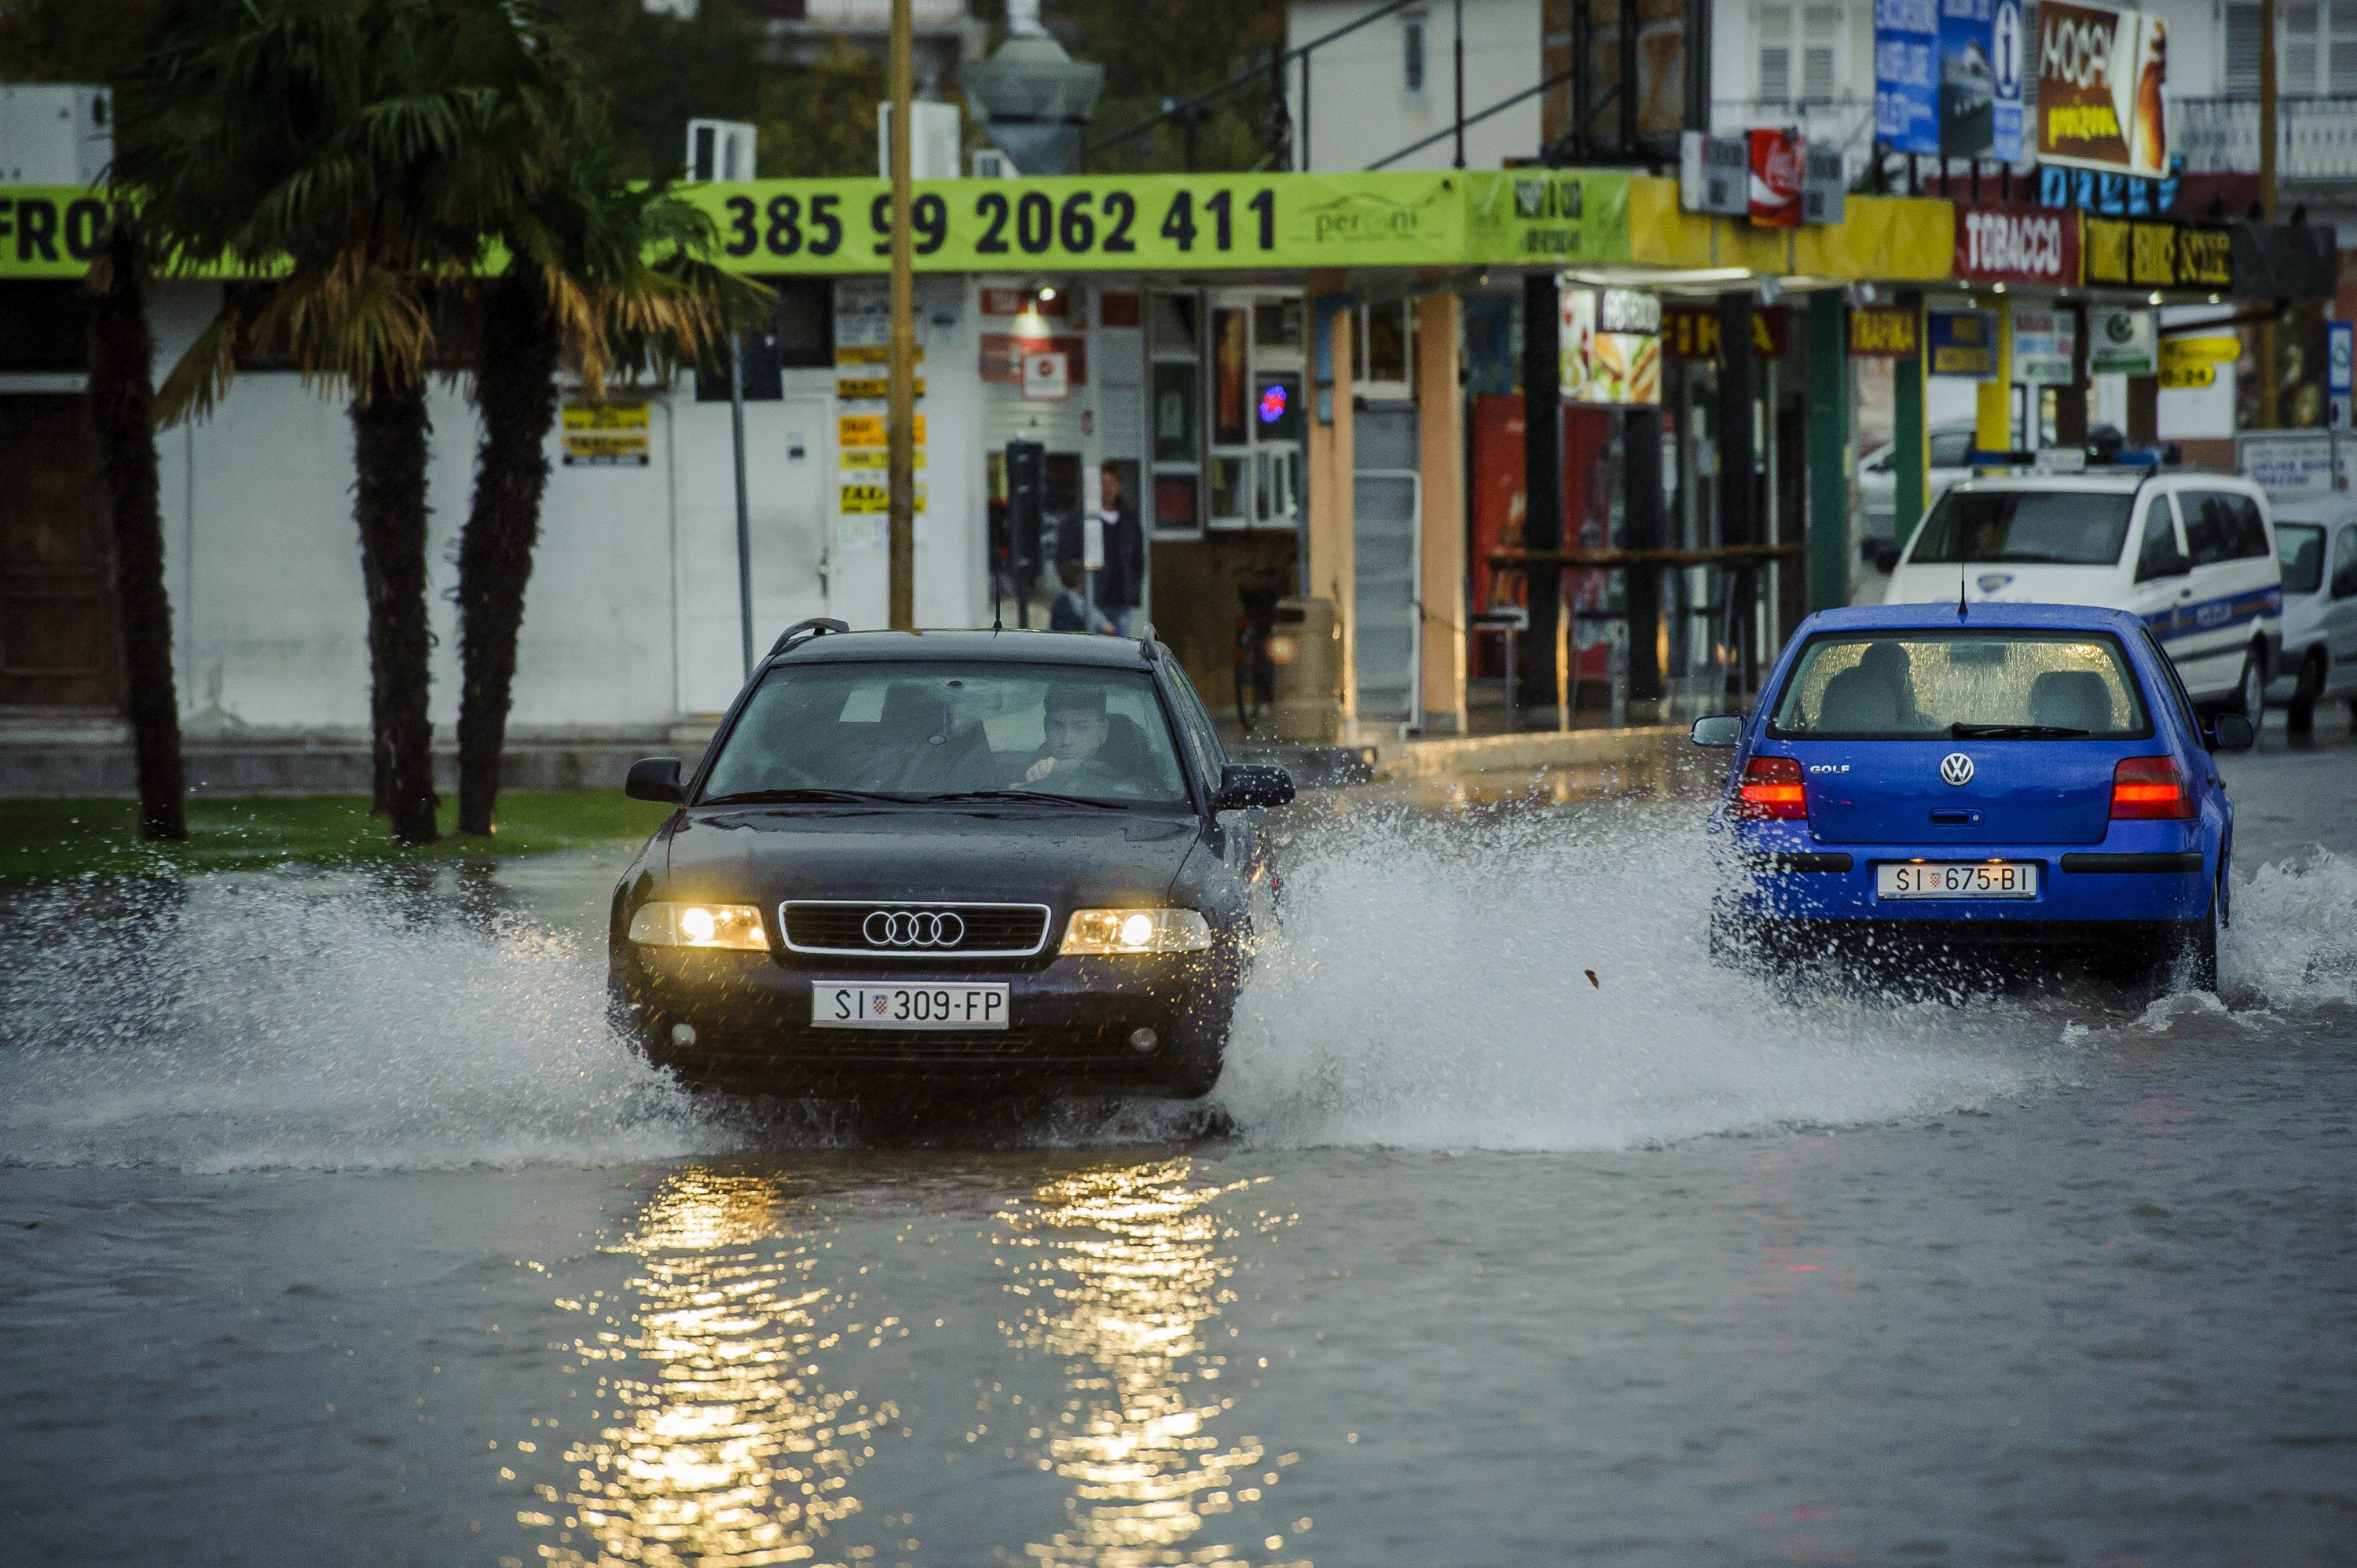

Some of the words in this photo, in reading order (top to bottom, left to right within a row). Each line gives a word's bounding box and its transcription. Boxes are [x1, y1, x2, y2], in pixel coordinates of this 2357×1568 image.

[725, 193, 842, 257] 385
[871, 192, 948, 256] 99
[976, 190, 1137, 254] 2062
[1160, 188, 1275, 251] 411
[1966, 211, 2061, 273] TOBACCO
[1809, 764, 1850, 775] GOLF
[1945, 867, 2027, 891] 675-BI
[893, 990, 1002, 1021] 309-FP
